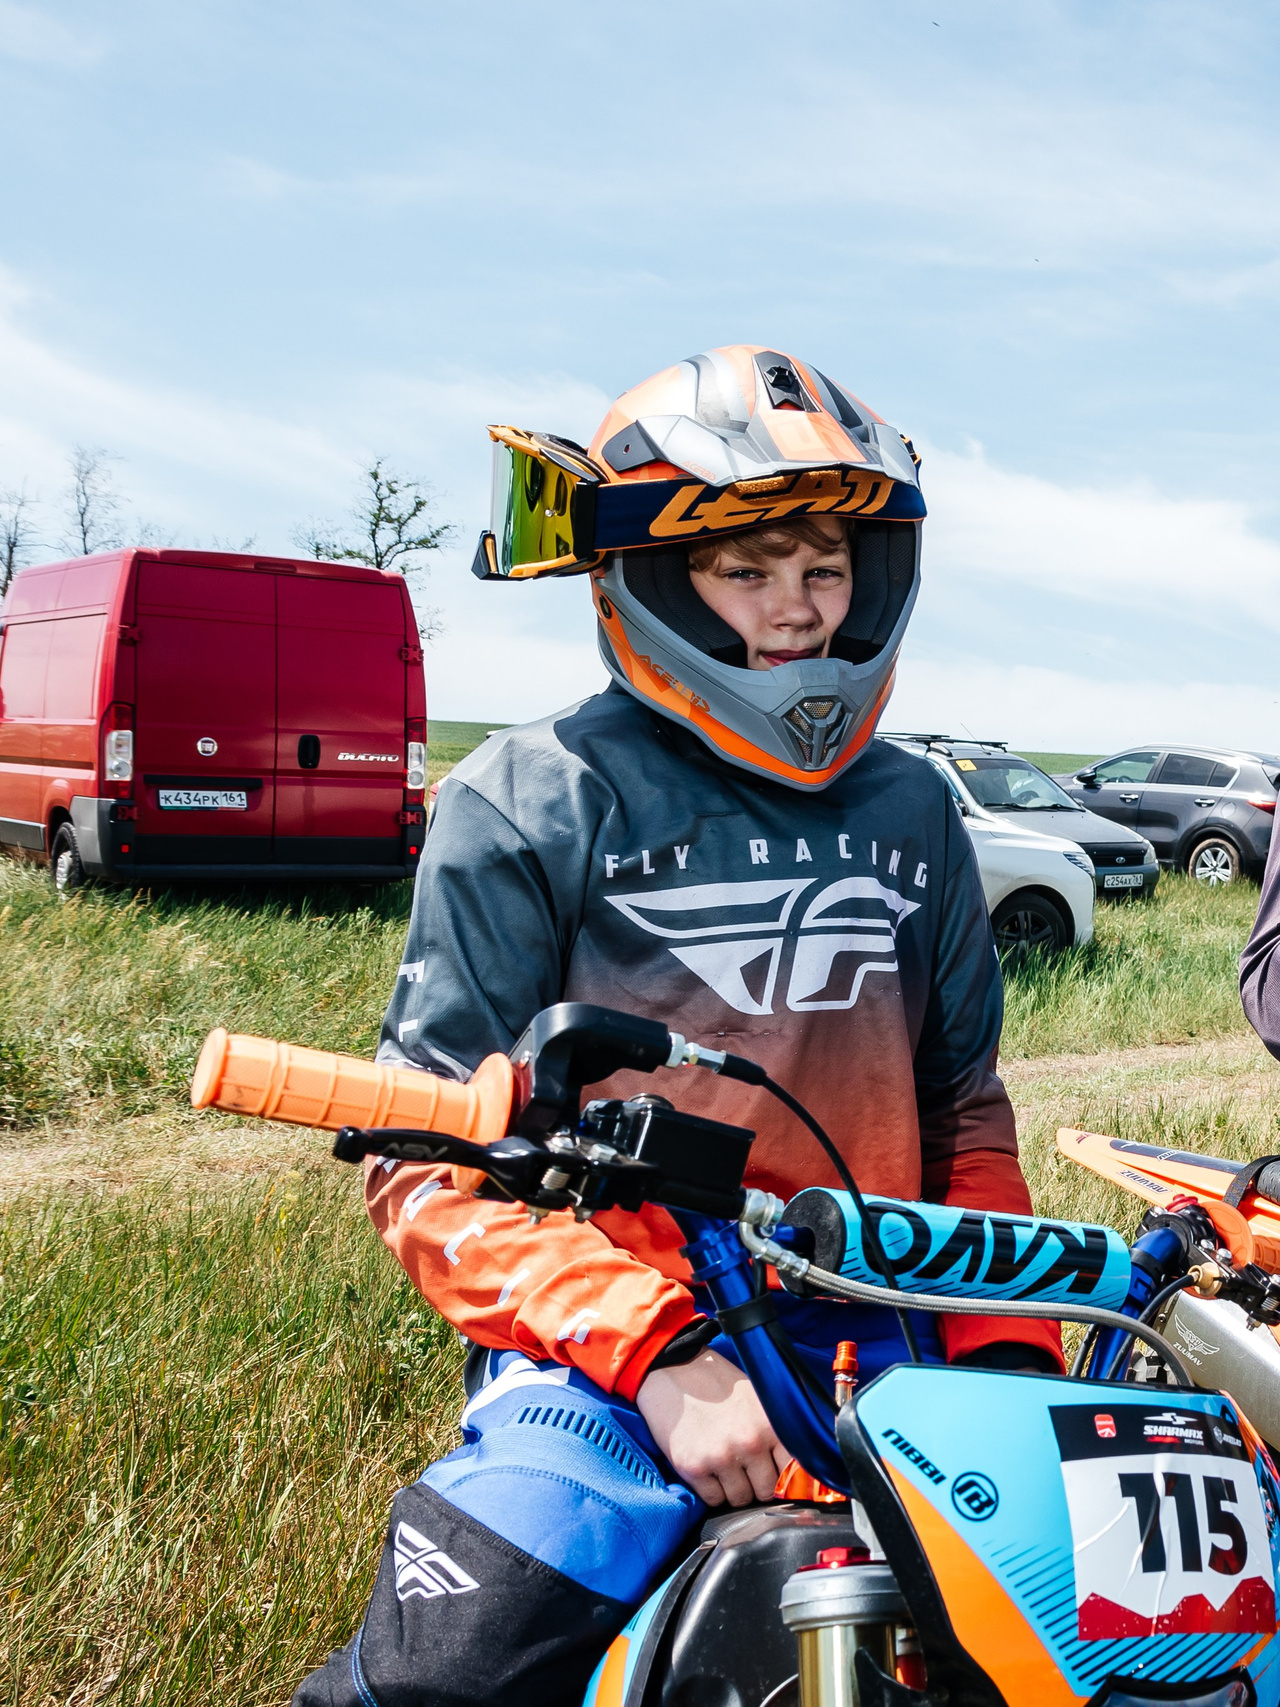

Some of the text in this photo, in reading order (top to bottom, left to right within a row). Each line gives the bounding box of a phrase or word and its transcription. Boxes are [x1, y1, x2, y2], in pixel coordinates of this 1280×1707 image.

[337, 751, 400, 762] DUCATO
[604, 833, 928, 889] FLY RACING
[1118, 1472, 1248, 1576] 115
